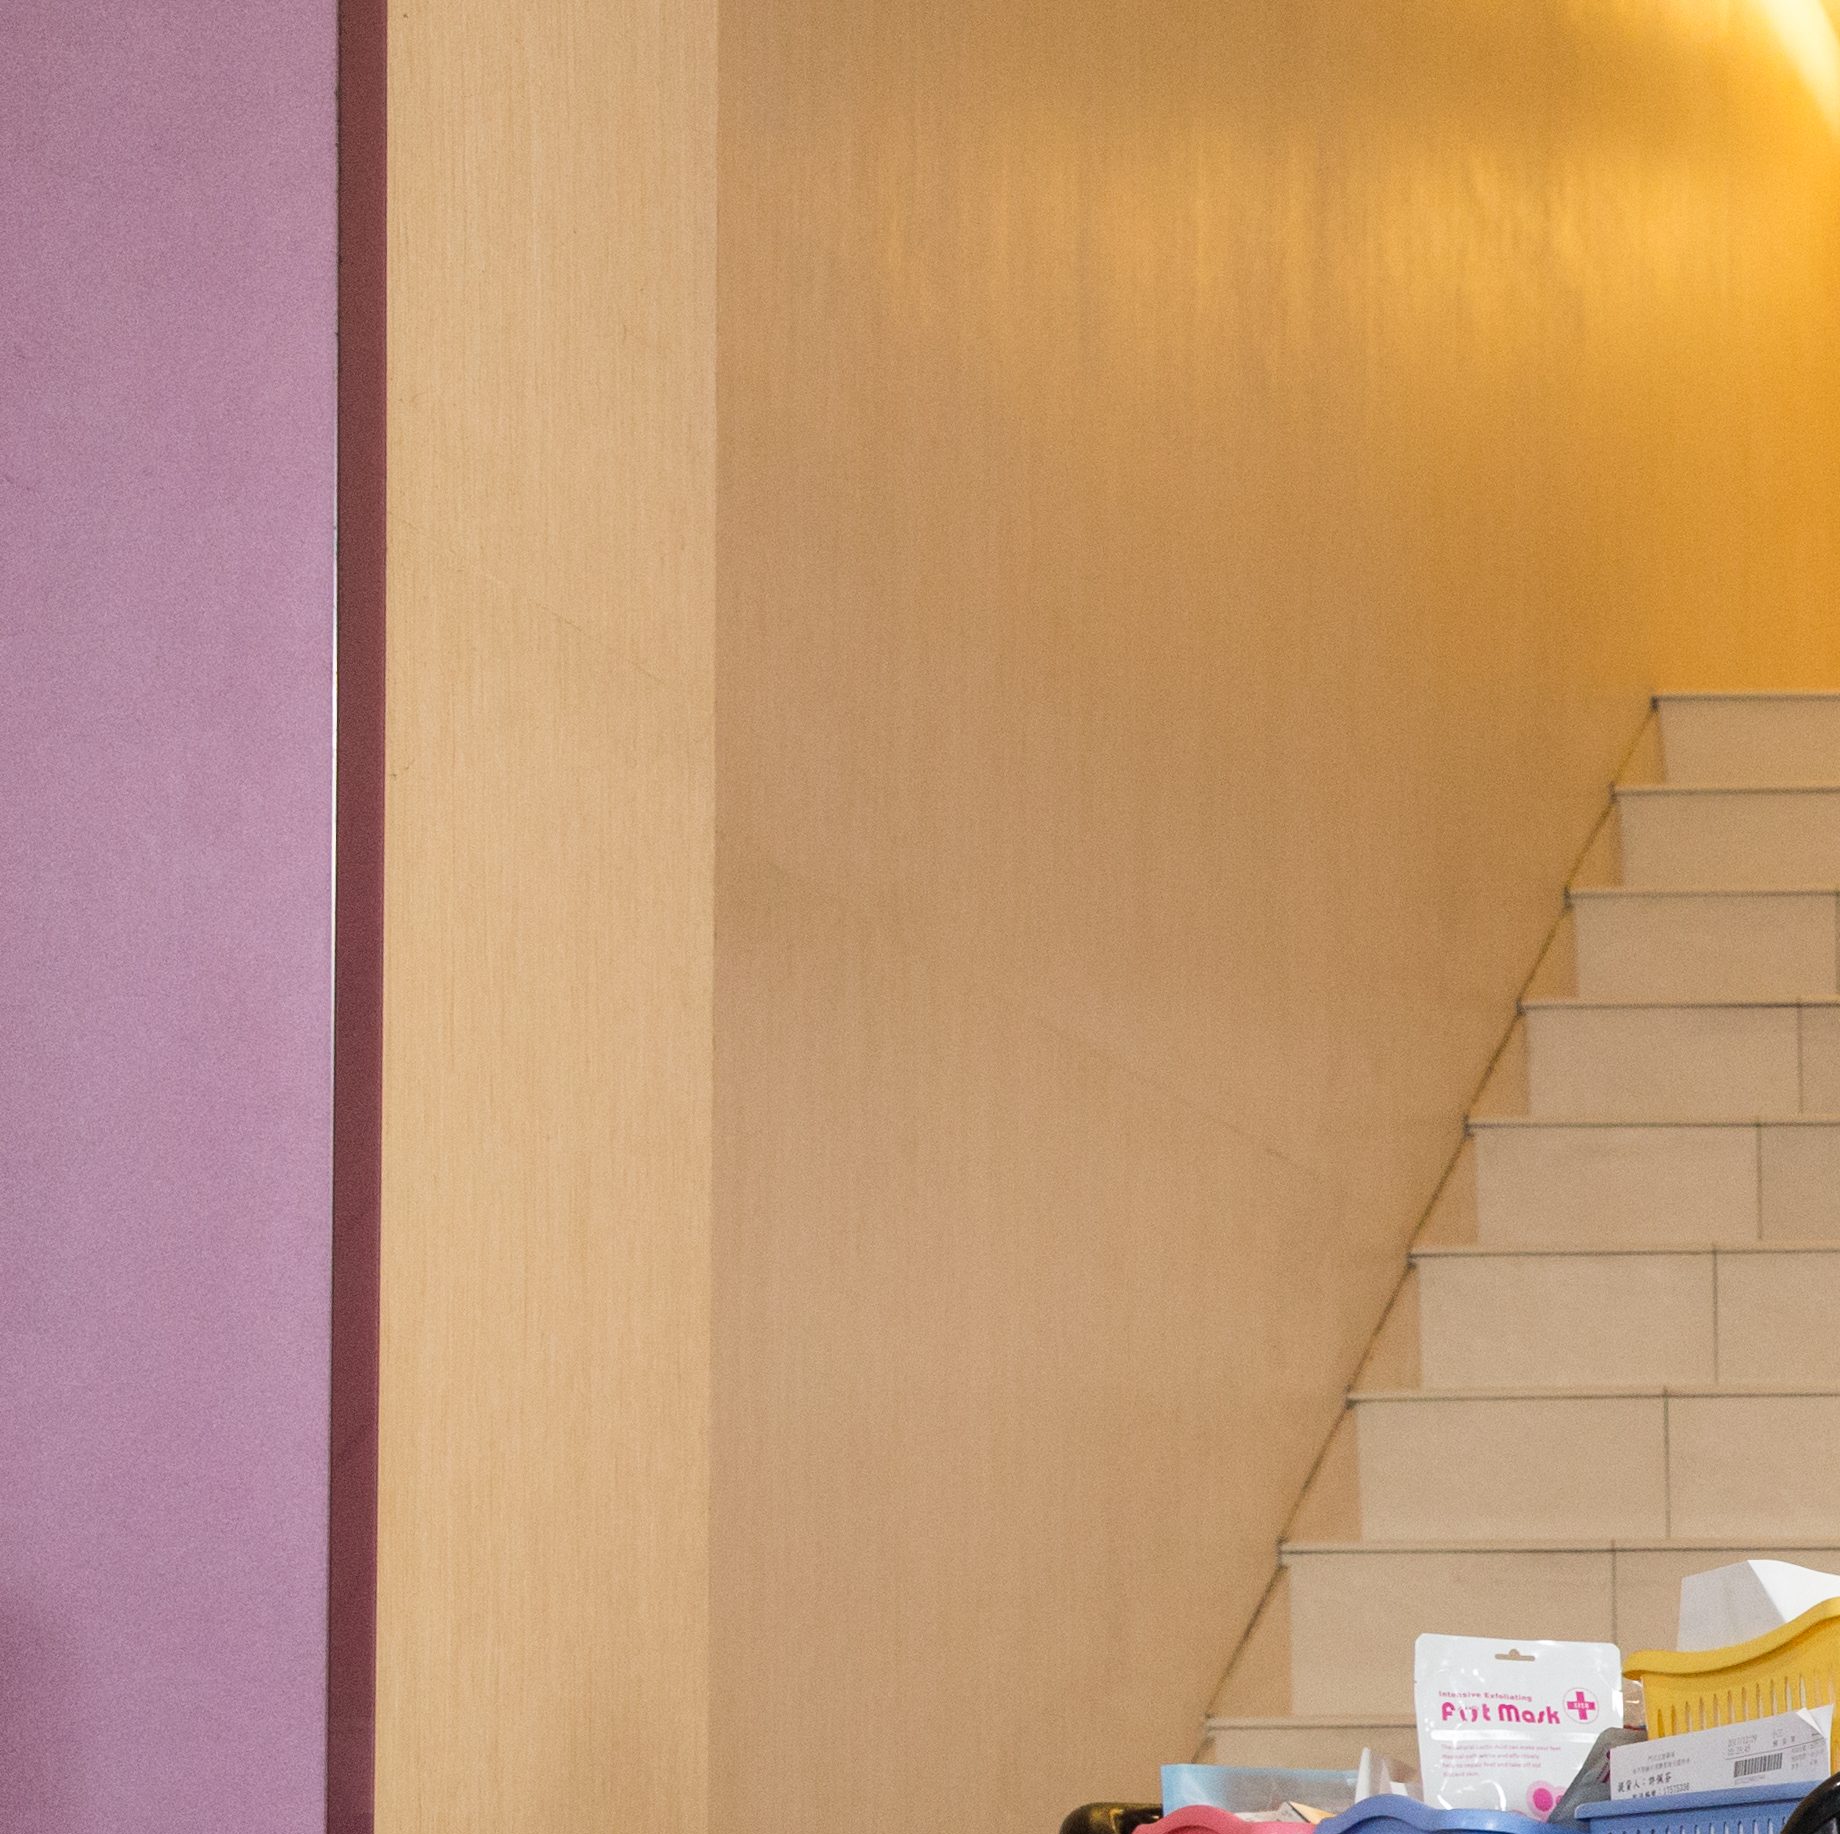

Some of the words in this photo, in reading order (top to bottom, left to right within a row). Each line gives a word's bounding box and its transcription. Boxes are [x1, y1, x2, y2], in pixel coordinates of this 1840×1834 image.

[1438, 1690, 1481, 1698] Intensive
[1484, 1692, 1532, 1702] Exfoliating
[1498, 1703, 1561, 1724] Mask
